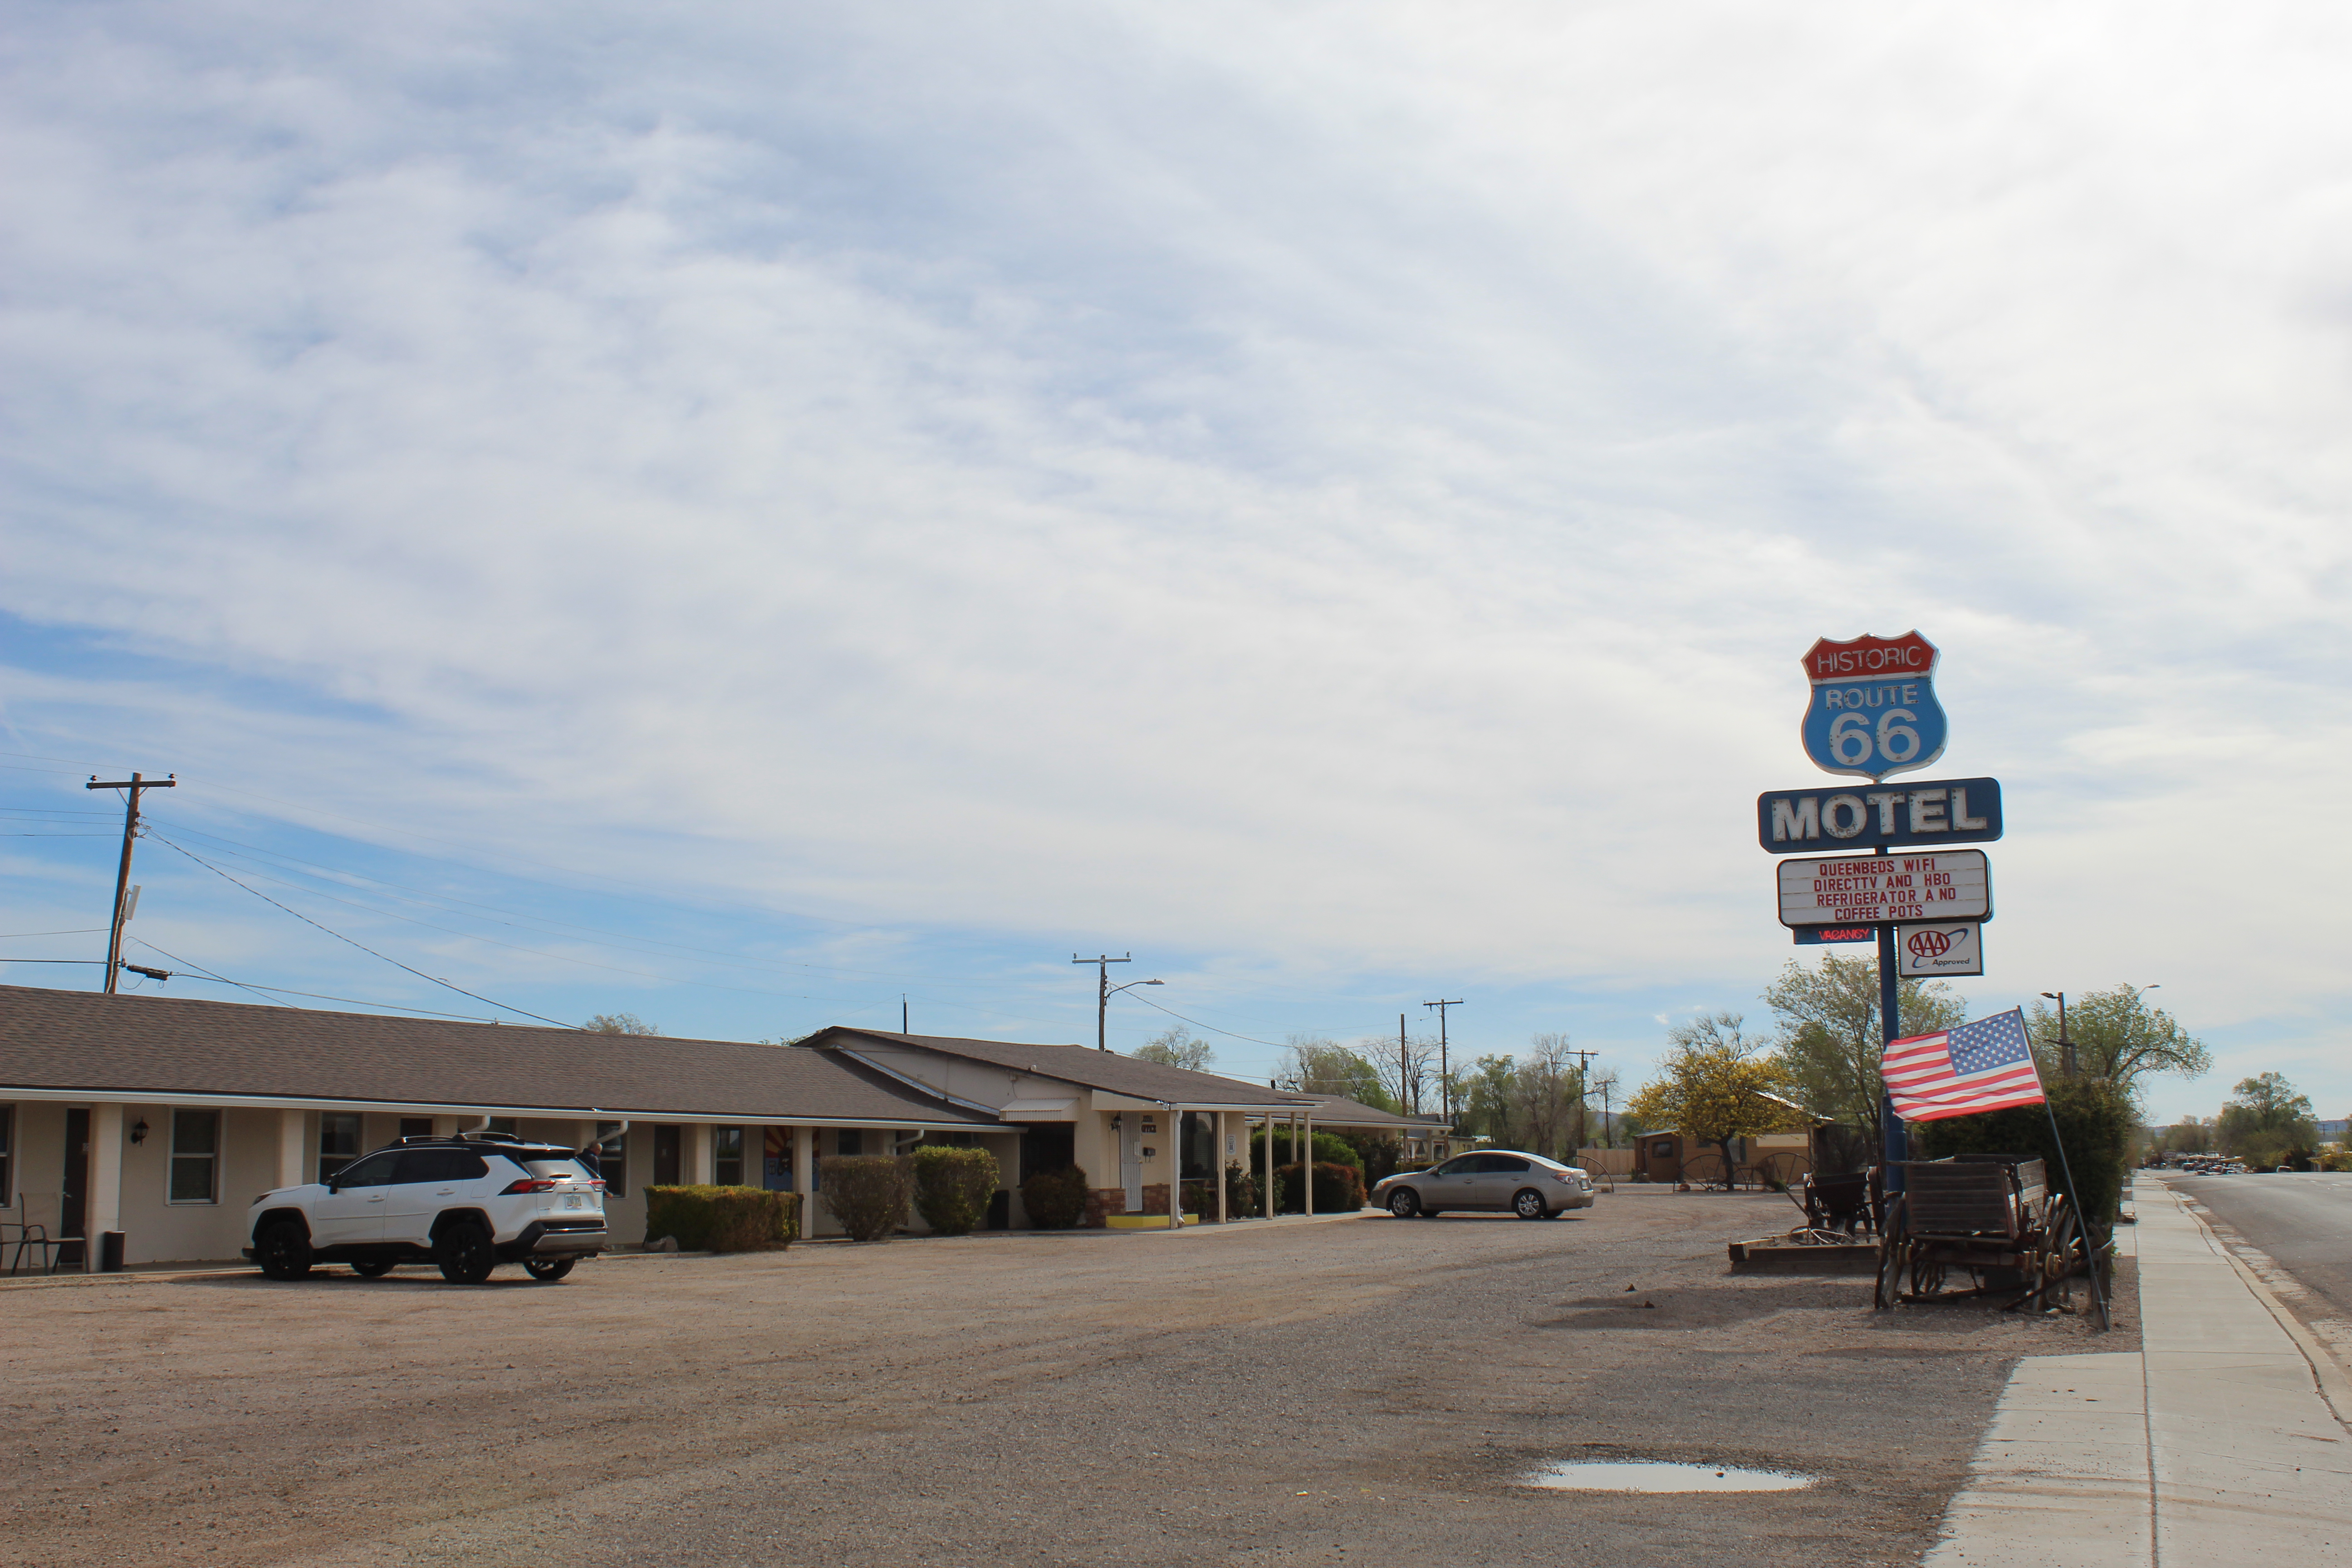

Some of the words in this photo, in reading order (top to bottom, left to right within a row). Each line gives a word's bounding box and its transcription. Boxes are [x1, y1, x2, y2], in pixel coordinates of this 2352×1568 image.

[1817, 646, 1923, 672] HISTORIC
[1825, 684, 1919, 710] ROUTE
[1829, 708, 1921, 766] 66
[1771, 787, 1987, 842] MOTEL
[1819, 860, 1894, 876] QUEENBEDS
[1904, 858, 1935, 872] WIFI
[1814, 876, 1877, 892] DIRECTTV
[1886, 875, 1912, 888] AND
[1924, 872, 1950, 886] HBO
[1817, 890, 1916, 906] REFRIGERATOR
[1835, 906, 1880, 921] COFFEE
[1889, 904, 1923, 918] POTS
[1818, 929, 1869, 941] VACANCY
[1910, 931, 1948, 957] AAA
[1932, 958, 1970, 967] Approved
